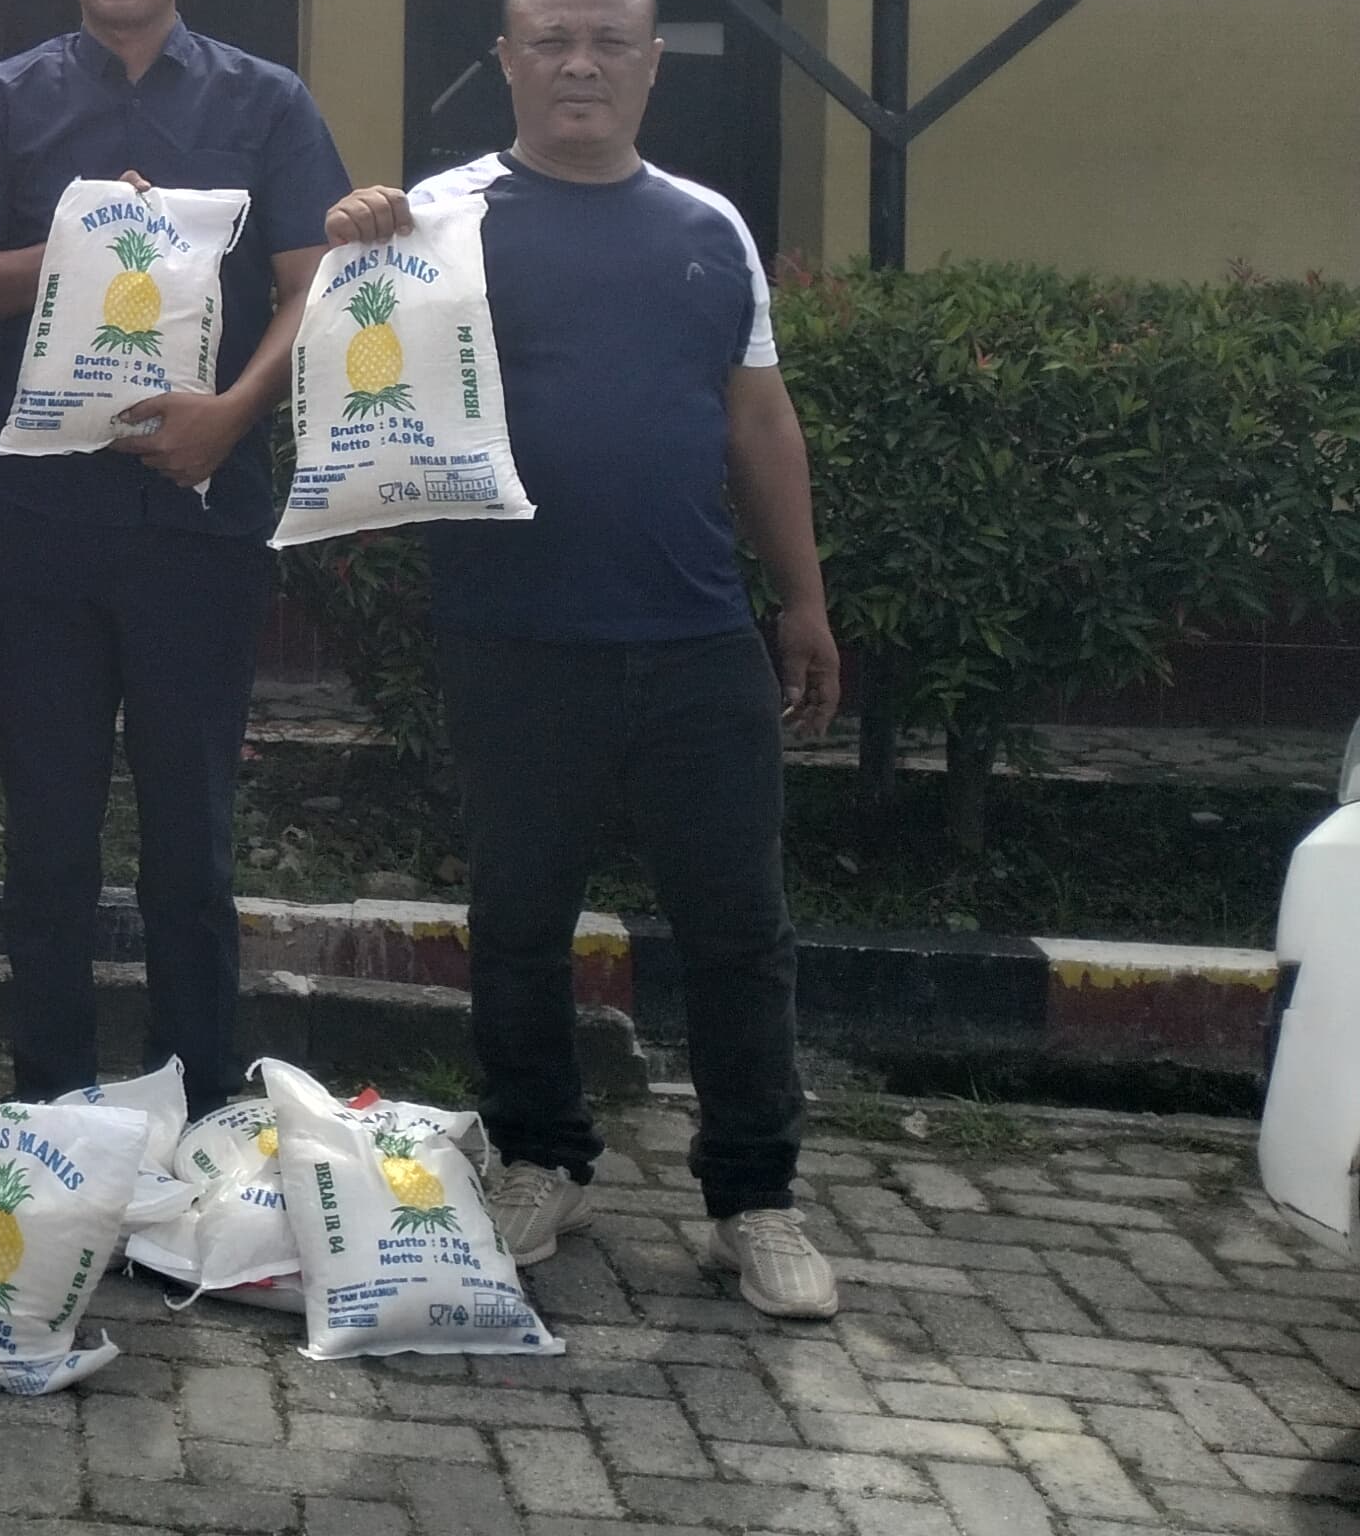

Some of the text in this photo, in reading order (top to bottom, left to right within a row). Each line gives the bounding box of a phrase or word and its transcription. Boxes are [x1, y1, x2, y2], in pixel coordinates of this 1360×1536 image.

[81, 203, 191, 253] NENAS MANIS
[43, 273, 60, 318] BERAS
[38, 323, 50, 337] IR
[460, 347, 476, 364] IR
[73, 368, 113, 381] Netto
[75, 355, 119, 368] Brutto
[134, 360, 142, 371] 5
[147, 361, 166, 378] Kg
[331, 423, 374, 438] Brutto
[388, 417, 398, 428] 5
[402, 417, 424, 432] Kg
[18, 1130, 84, 1190] MANIS
[314, 1162, 337, 1210] BERAS
[324, 1215, 341, 1232] IR
[378, 1238, 426, 1251] Brutto
[453, 1237, 470, 1253] Kg
